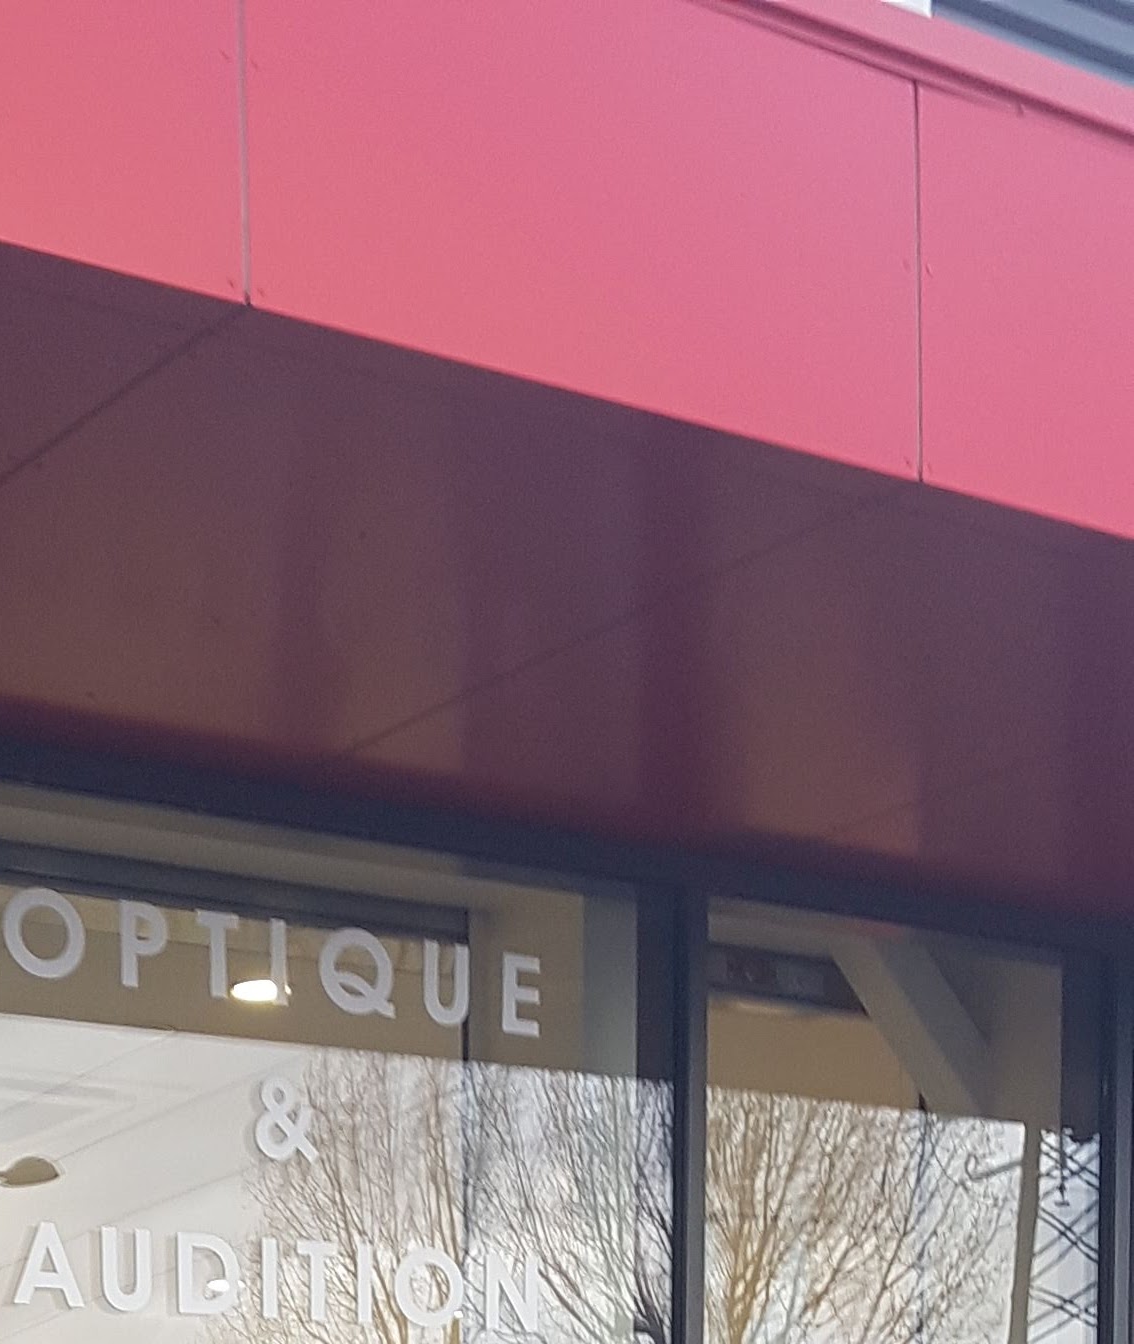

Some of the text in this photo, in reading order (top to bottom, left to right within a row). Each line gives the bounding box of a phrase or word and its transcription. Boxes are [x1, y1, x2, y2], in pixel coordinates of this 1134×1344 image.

[2, 887, 542, 1038] OPTIQUE
[254, 1077, 318, 1163] &
[13, 1220, 541, 1331] AUDITION
